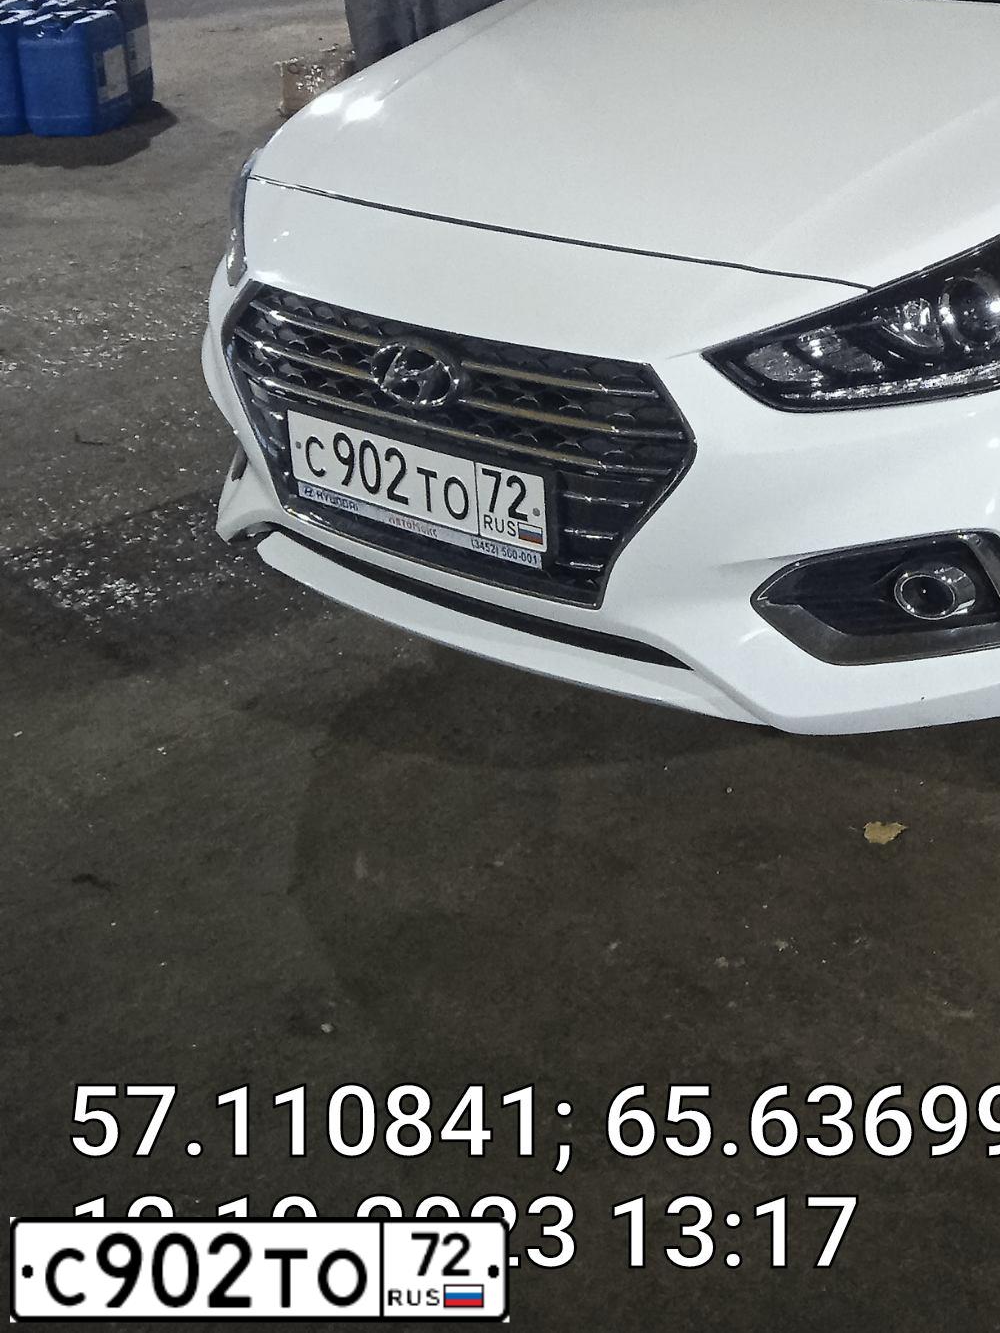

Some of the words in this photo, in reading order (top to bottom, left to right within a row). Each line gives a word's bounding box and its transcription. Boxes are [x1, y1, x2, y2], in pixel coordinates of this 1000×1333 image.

[305, 432, 469, 520] С902ТО
[481, 467, 528, 522] 72
[483, 514, 517, 537] RUS
